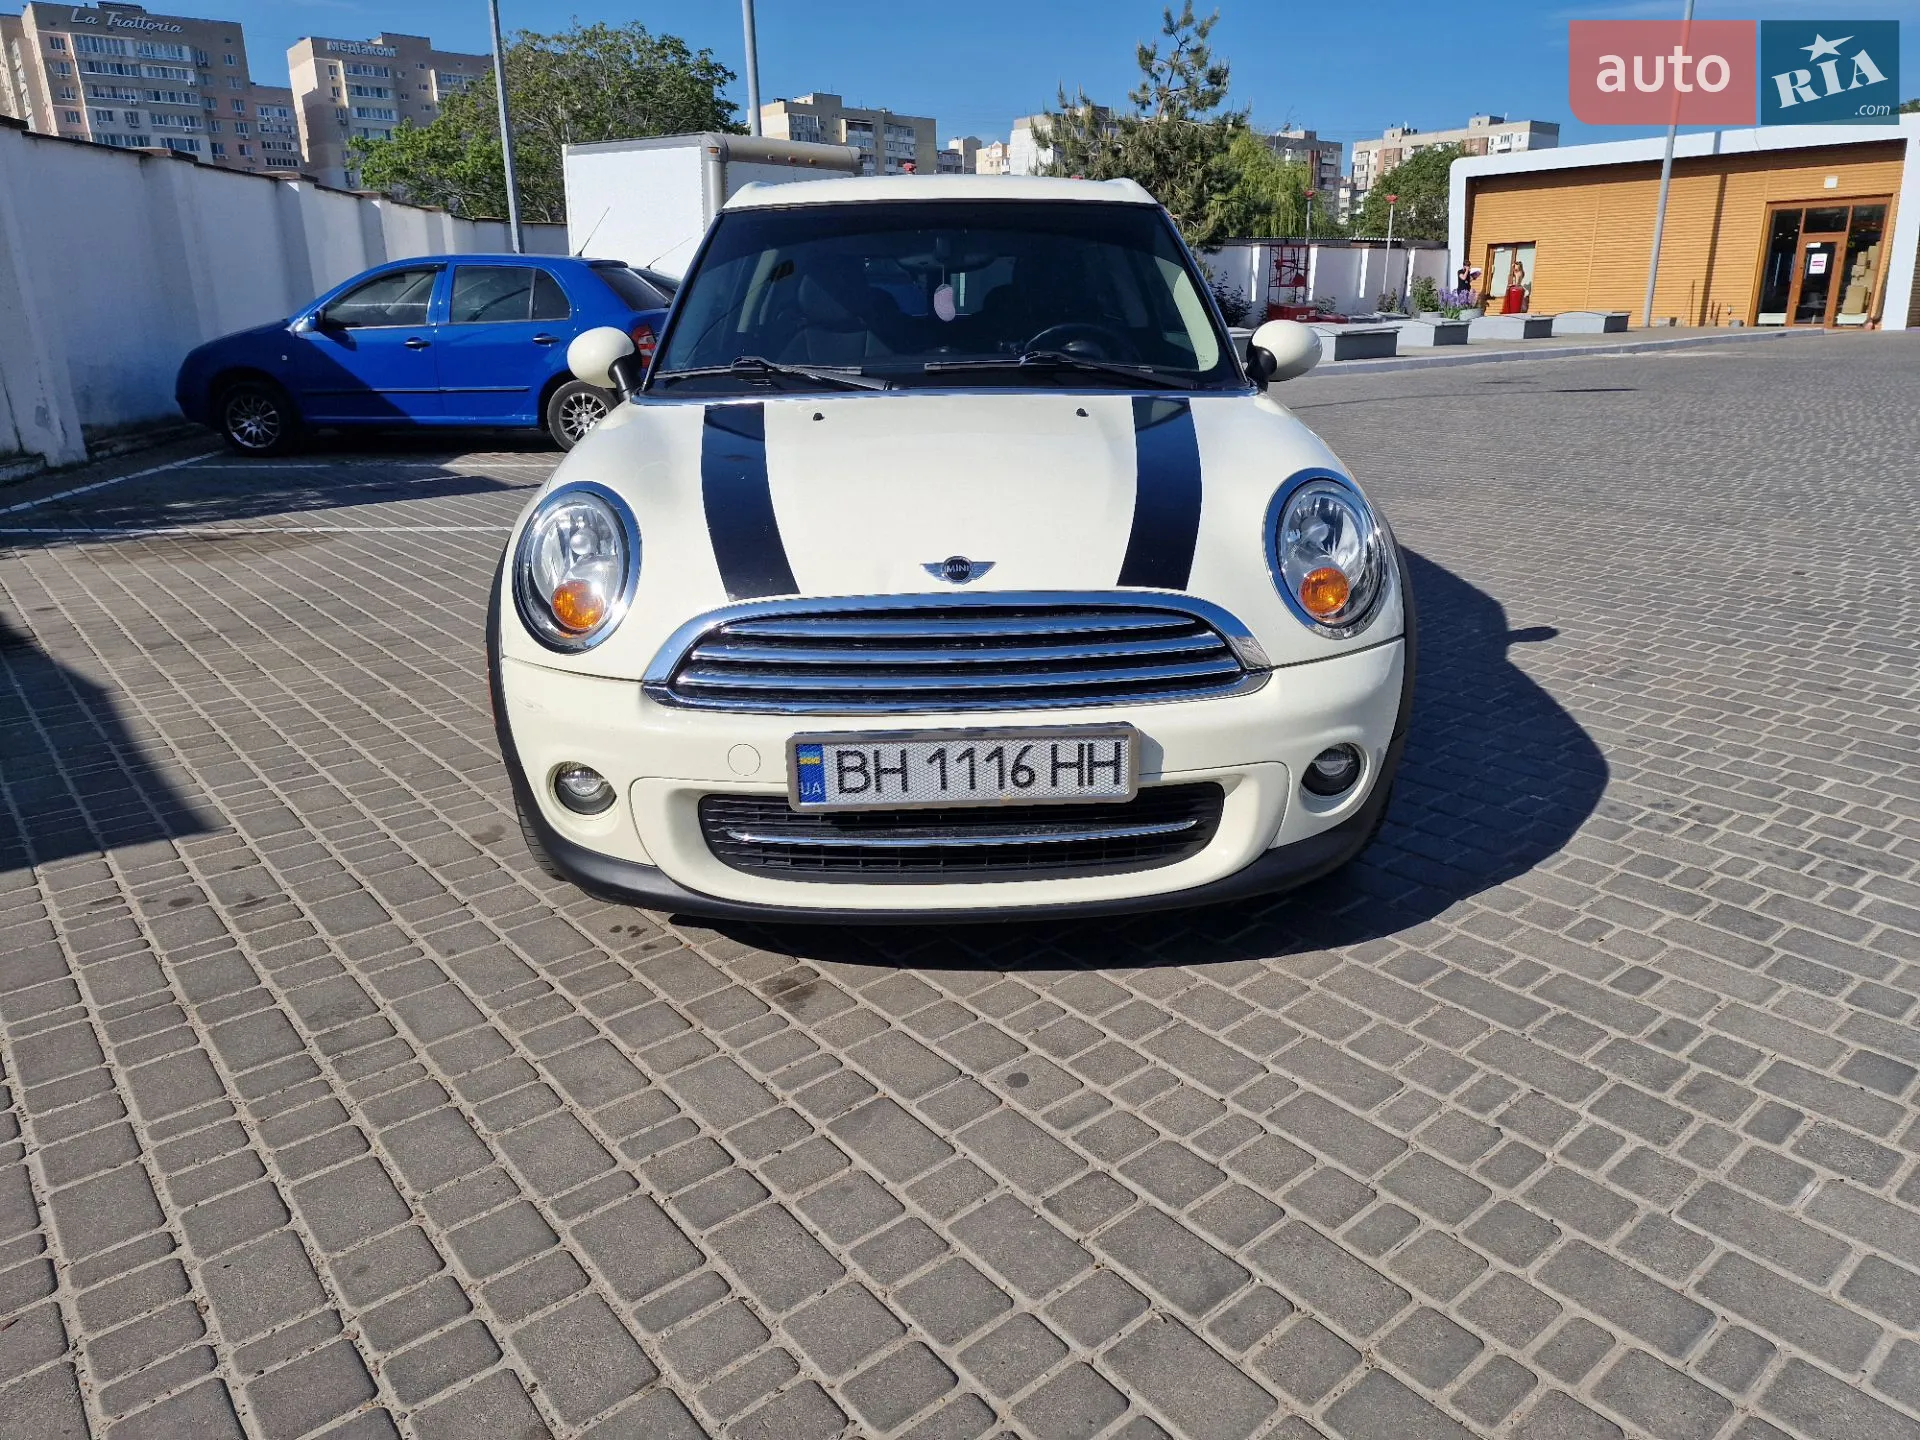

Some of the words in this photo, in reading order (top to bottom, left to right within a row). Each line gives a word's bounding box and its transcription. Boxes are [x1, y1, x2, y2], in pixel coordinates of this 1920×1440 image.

[70, 8, 98, 24] La
[106, 11, 182, 33] Trattoria
[946, 563, 969, 573] MINI
[836, 749, 907, 795] BH
[926, 745, 1035, 791] 1116
[1050, 741, 1121, 787] HH
[800, 782, 821, 795] UA
